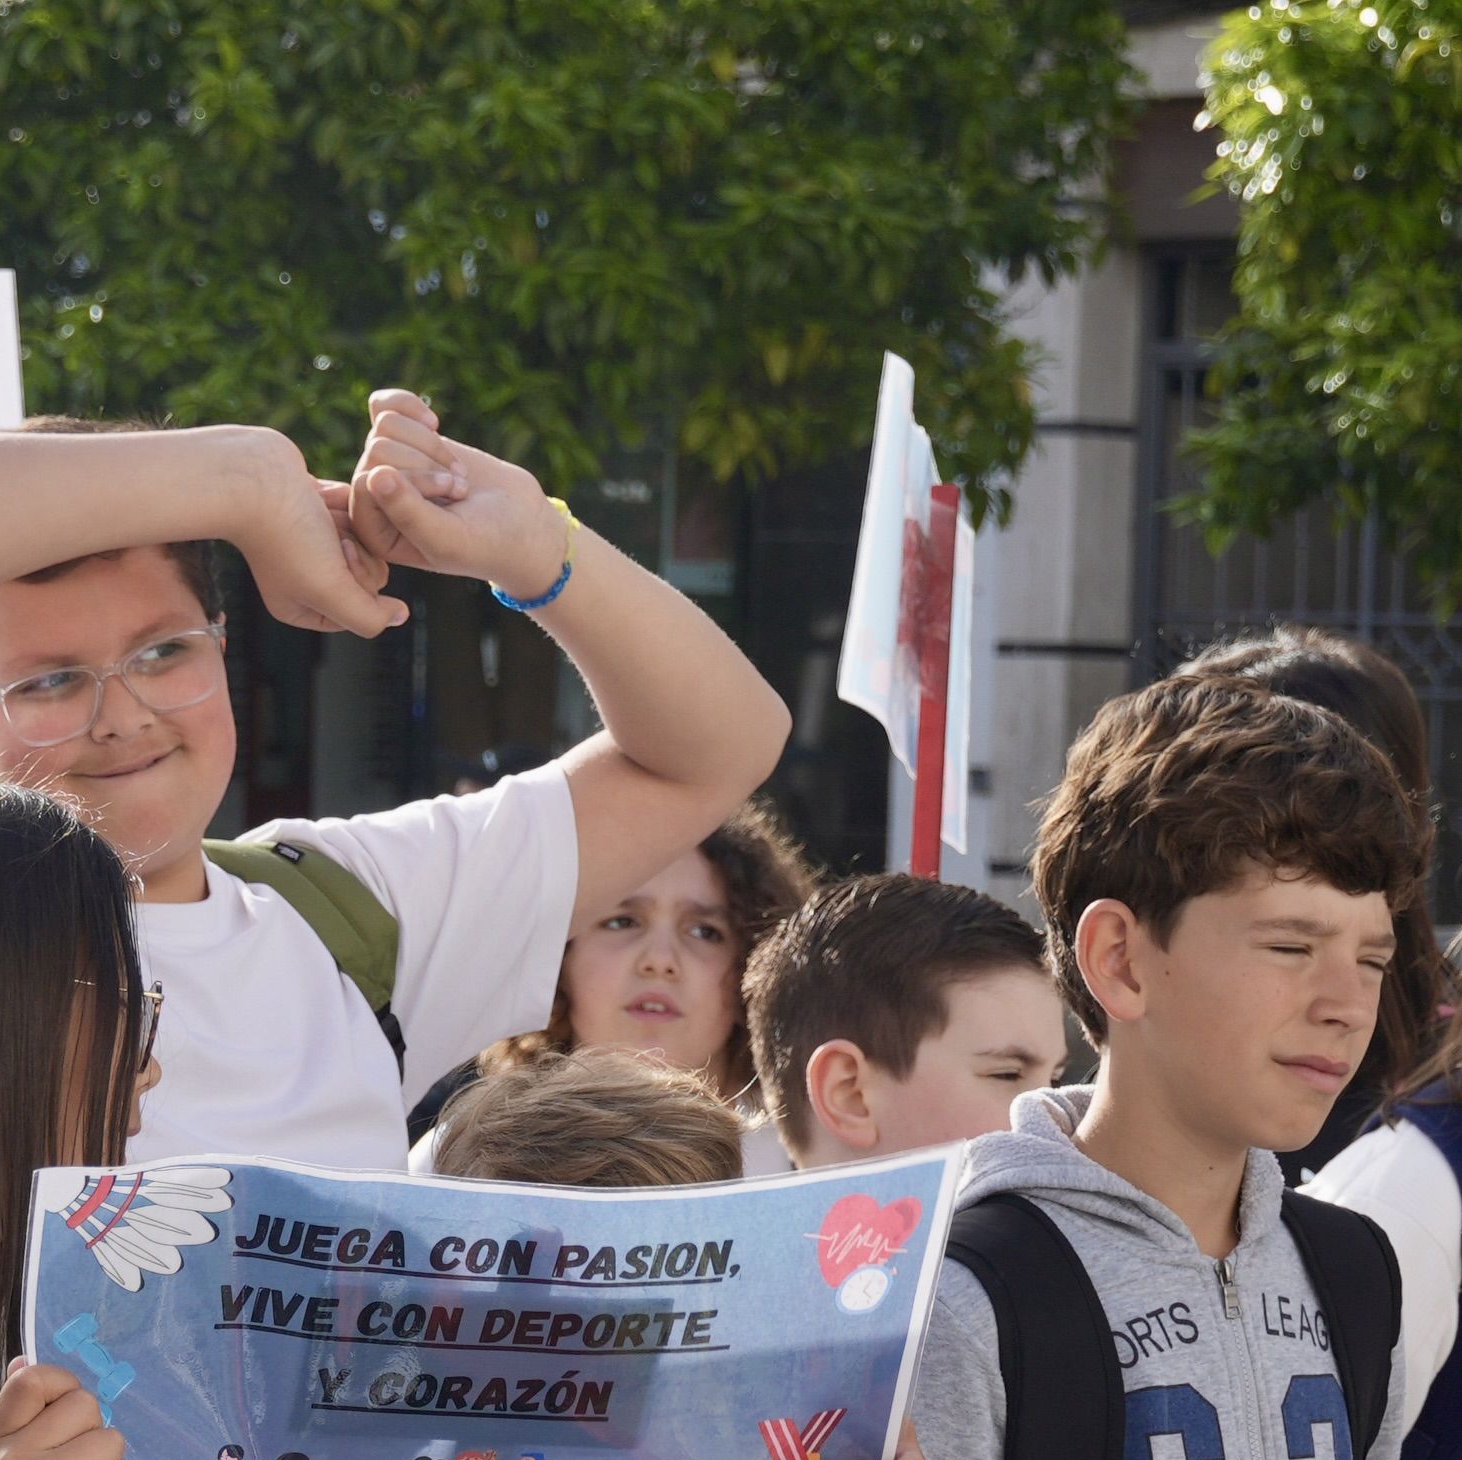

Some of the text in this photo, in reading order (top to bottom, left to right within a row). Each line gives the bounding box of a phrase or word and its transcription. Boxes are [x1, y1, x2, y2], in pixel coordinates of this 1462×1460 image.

[234, 1214, 742, 1281] JUEGA CON PASION,
[219, 1285, 719, 1348] VIVE CON DEPORTE
[1112, 1292, 1330, 1369] ORTS LEAG
[318, 1367, 614, 1415] Y CORAZÓN
